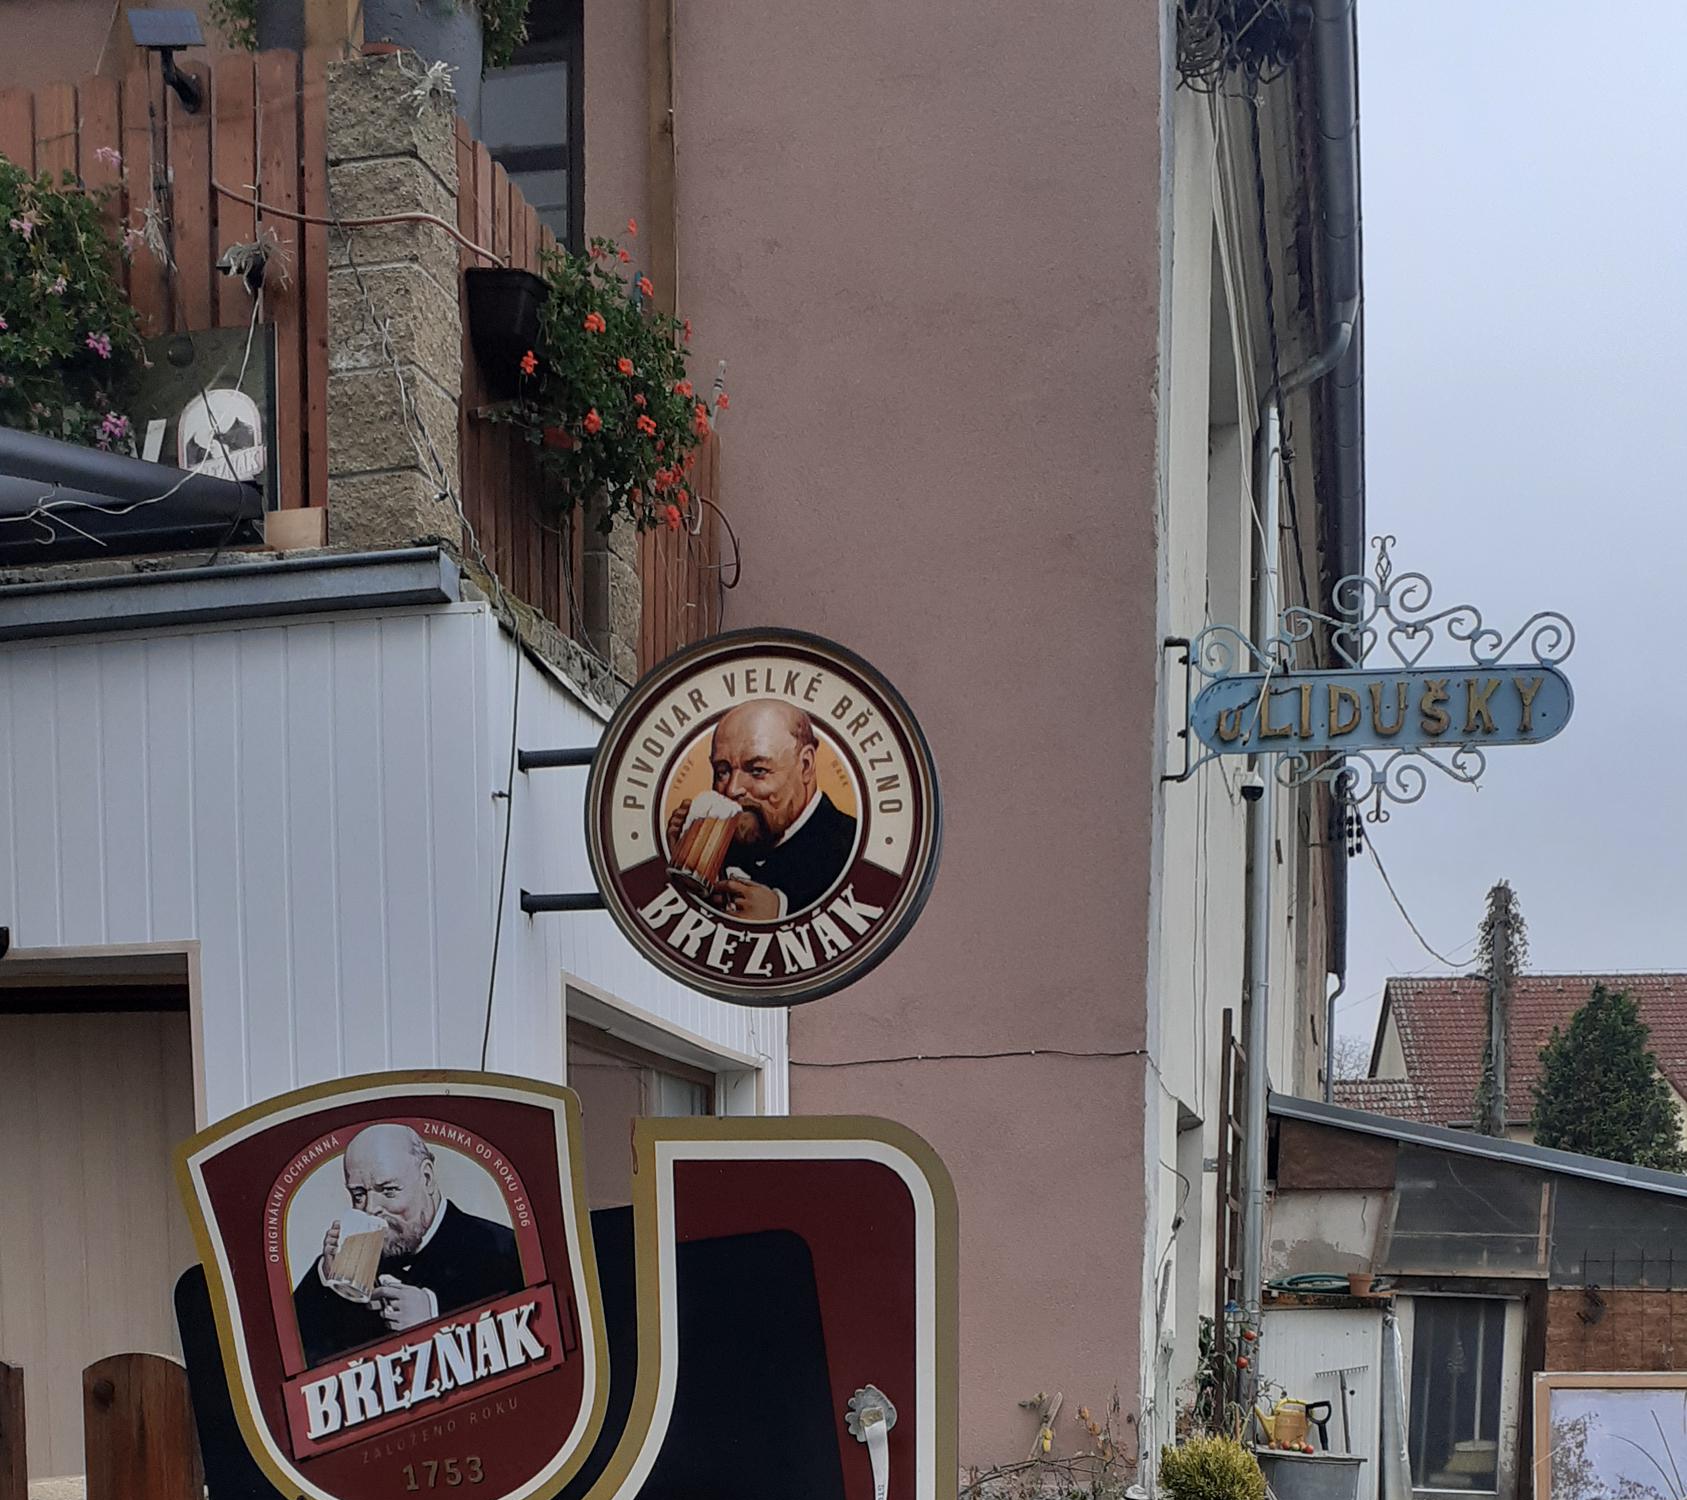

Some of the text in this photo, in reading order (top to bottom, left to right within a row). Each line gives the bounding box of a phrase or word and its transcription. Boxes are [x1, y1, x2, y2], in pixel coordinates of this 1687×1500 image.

[623, 667, 903, 815] PIVOVAR VELKÉ BŘEZNO
[1256, 677, 1545, 740] LIDUŠKY
[637, 882, 884, 977] BŘEZŇÁK
[268, 1135, 340, 1263] ORIGINÁLNÍ OCHRANNÁ
[423, 1122, 531, 1227] ZNÁMKA OD ROKU 1906
[301, 1301, 545, 1440] BŘEZŇÁK
[469, 1396, 518, 1424] ROKU
[402, 1455, 484, 1492] 1753
